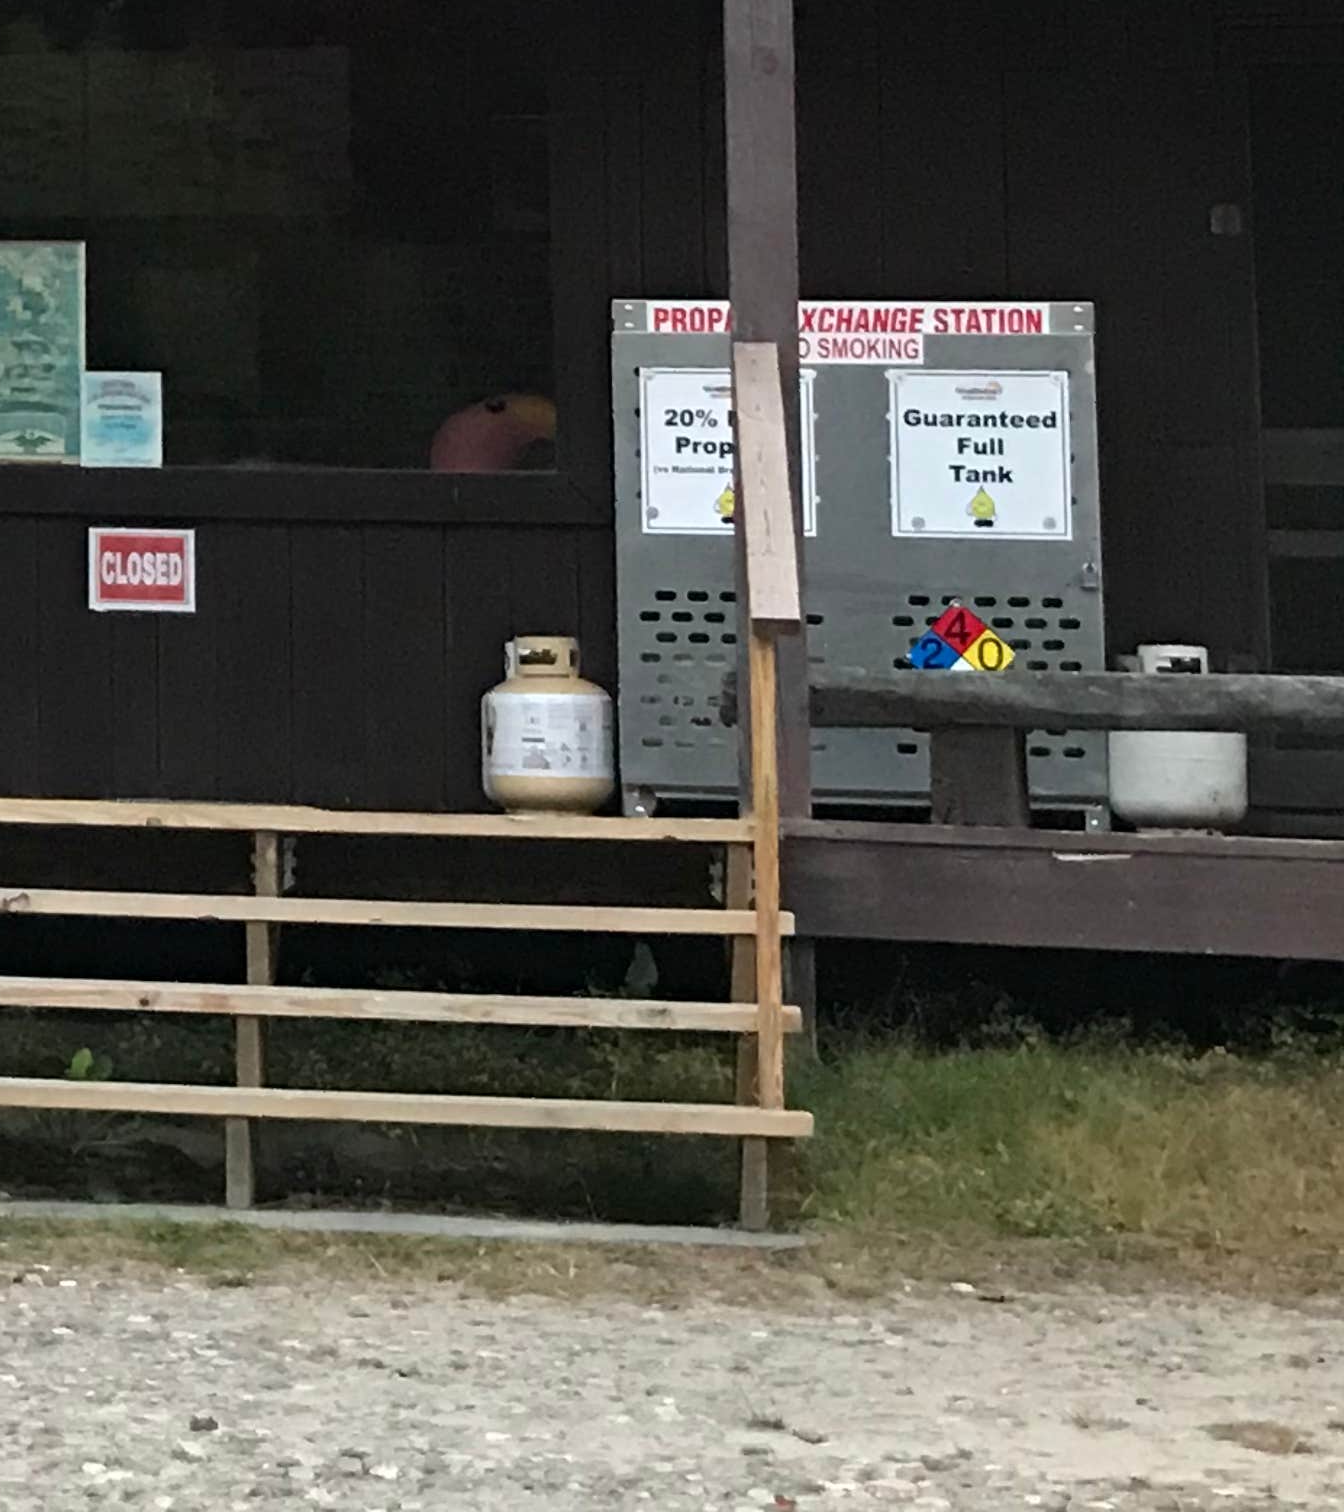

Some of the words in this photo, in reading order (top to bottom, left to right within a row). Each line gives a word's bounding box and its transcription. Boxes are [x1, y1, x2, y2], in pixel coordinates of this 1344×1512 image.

[653, 307, 733, 333] PROP
[800, 307, 924, 333] XCHANGE
[934, 308, 1043, 334] STATION
[817, 338, 920, 360] SMOKING
[664, 409, 719, 428] 20%
[903, 409, 1058, 429] Guaranteed
[675, 437, 735, 459] Prop
[957, 437, 1005, 456] Full
[948, 464, 1014, 484] Tank
[101, 550, 183, 587] CLOSED
[943, 609, 972, 646] 4
[920, 637, 945, 669] 2
[977, 637, 1004, 671] 0
